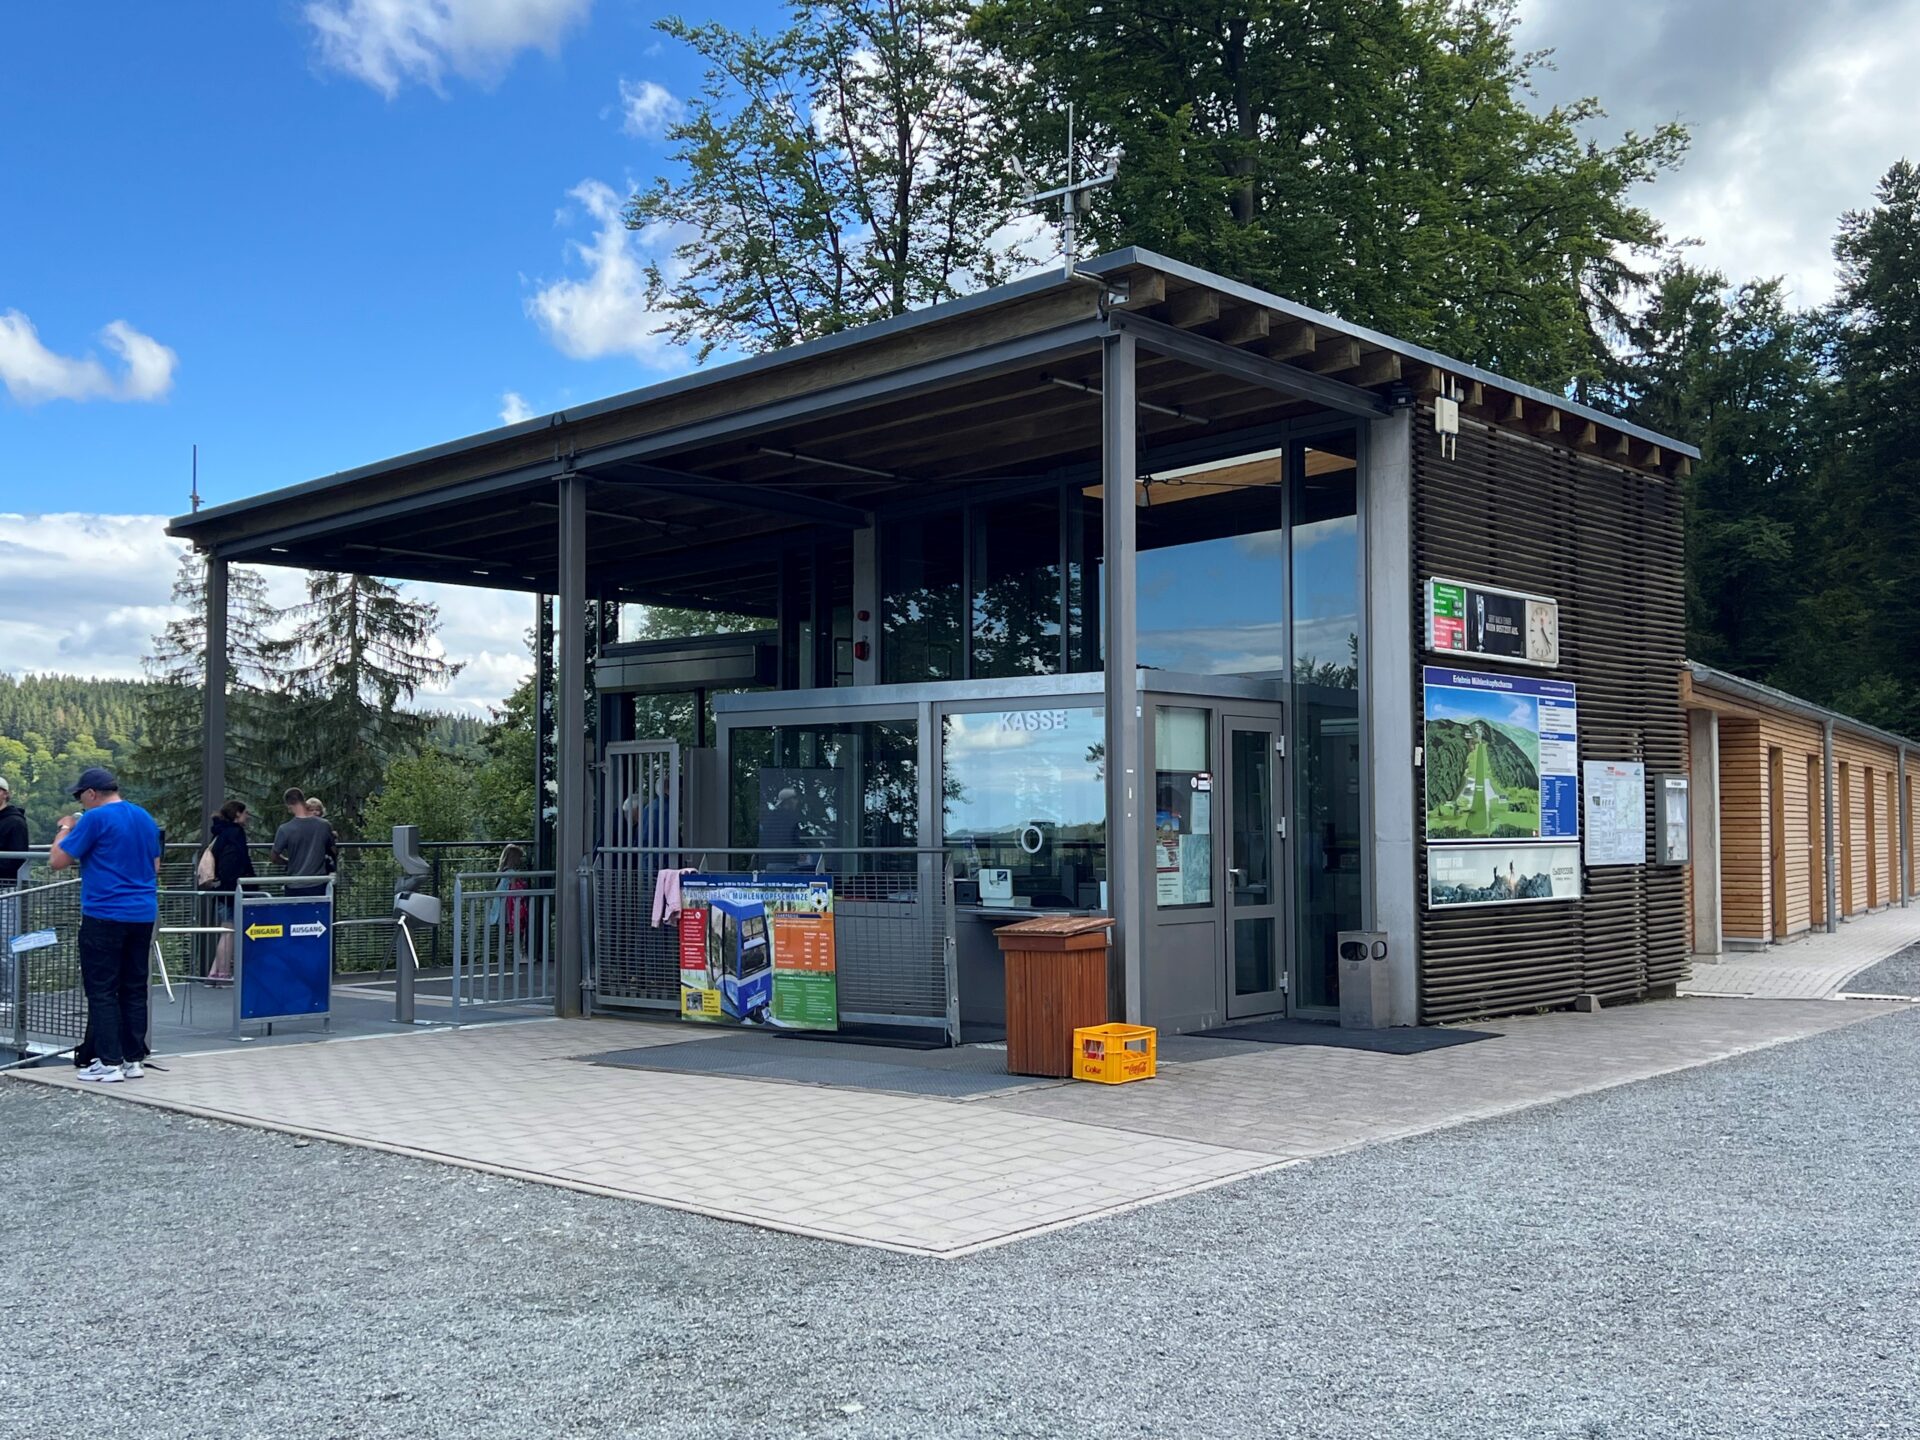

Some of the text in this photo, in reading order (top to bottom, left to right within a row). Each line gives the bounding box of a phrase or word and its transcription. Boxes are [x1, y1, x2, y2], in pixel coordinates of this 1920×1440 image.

[1000, 710, 1067, 731] KASSE
[250, 927, 280, 936] EINGANG
[292, 926, 323, 934] AUSGANG
[1085, 1065, 1101, 1074] Coke
